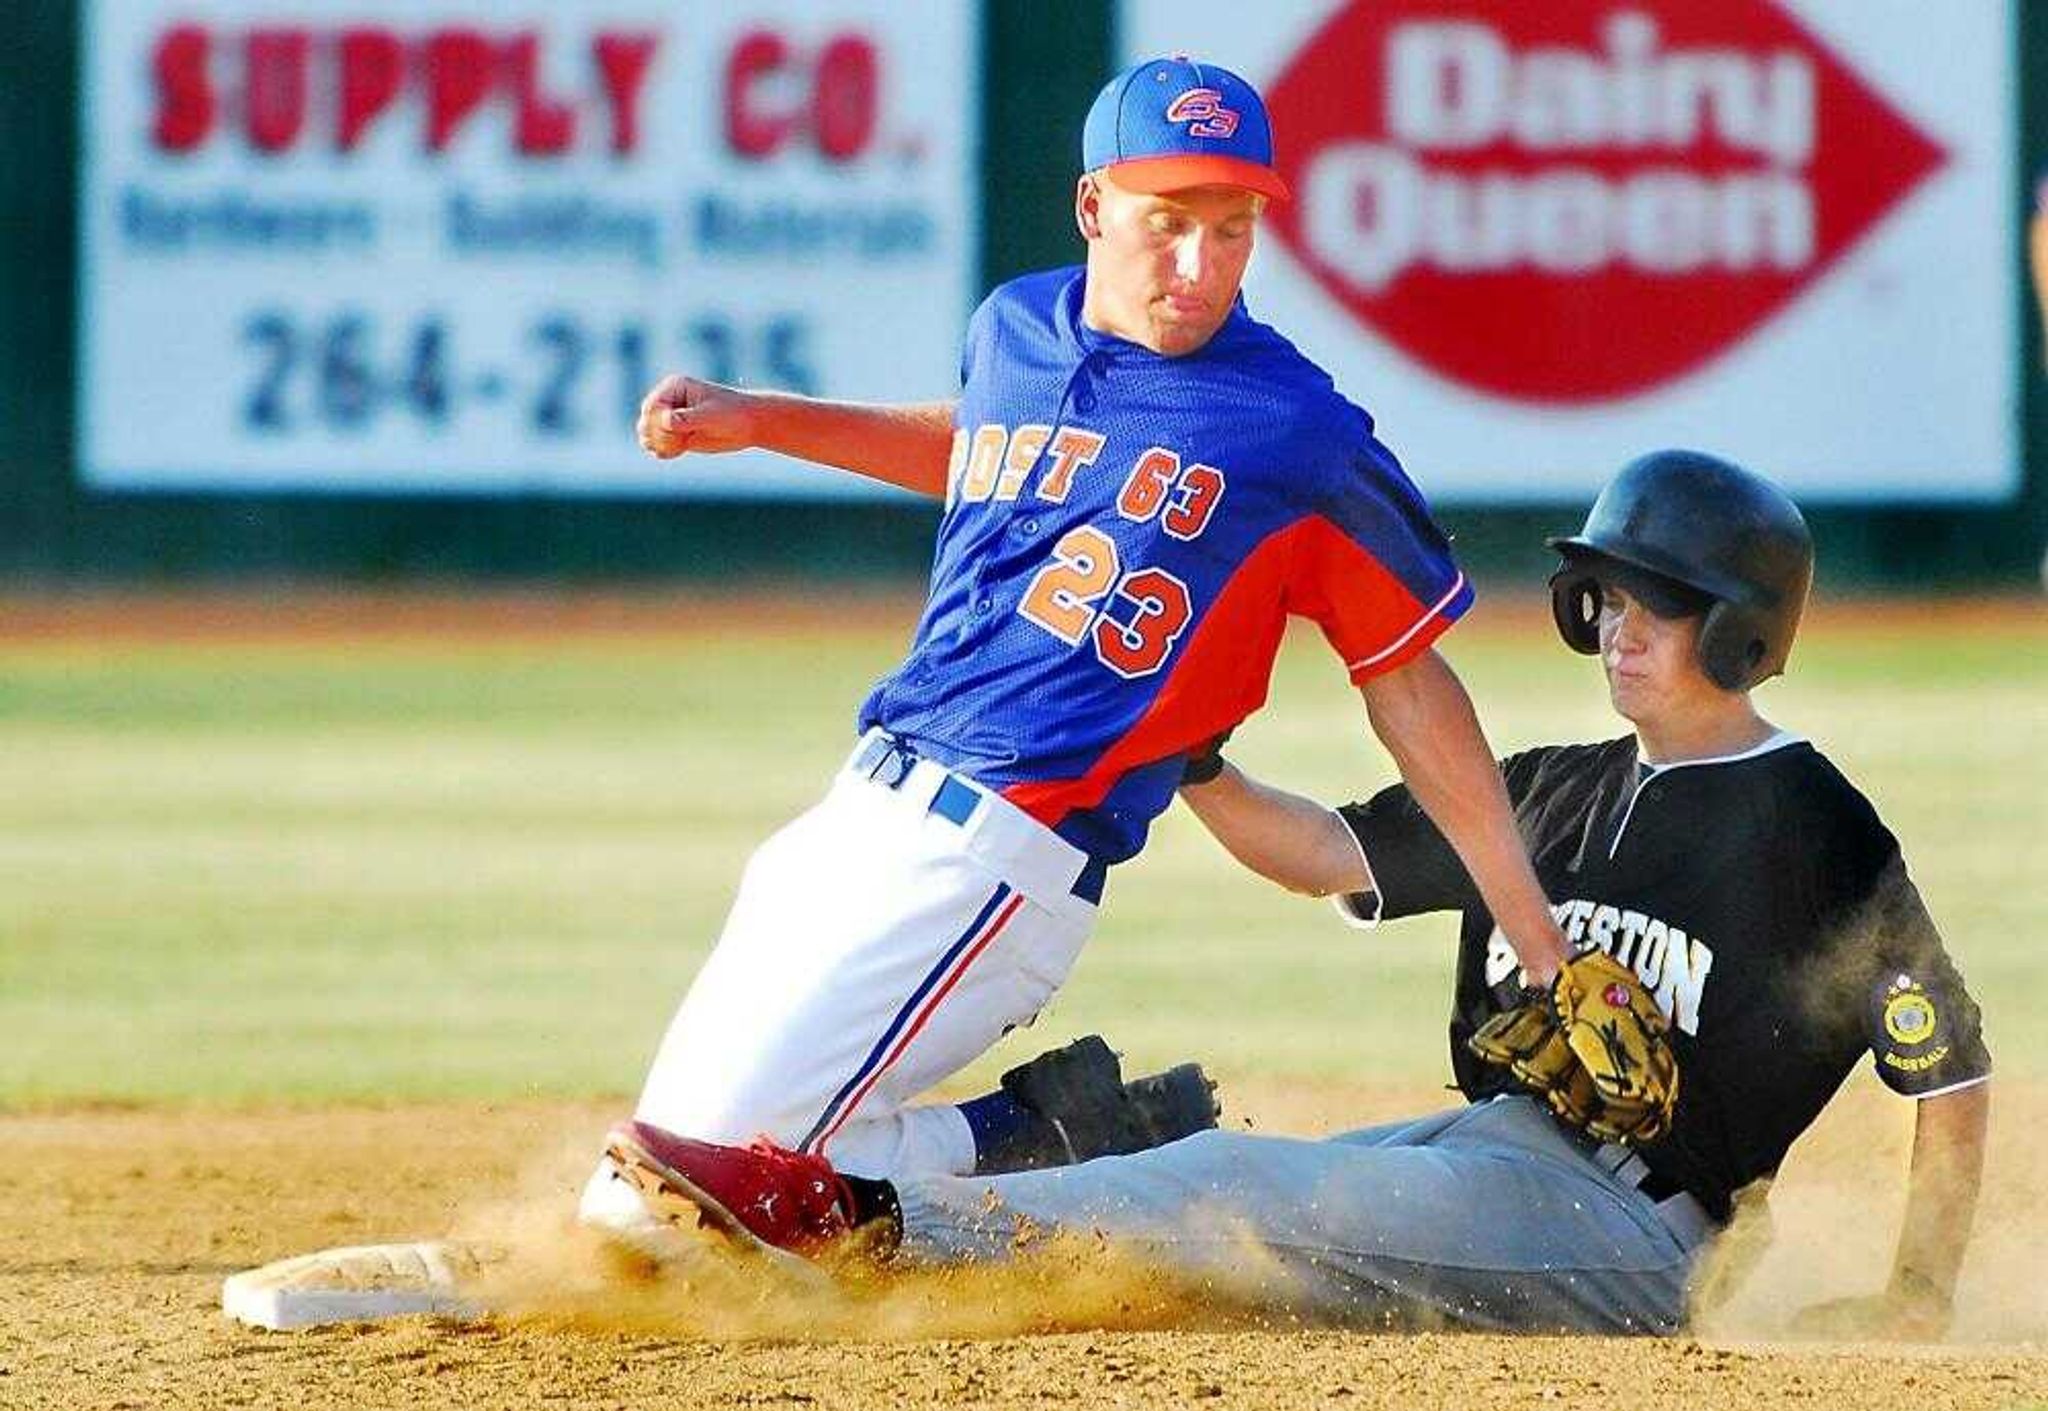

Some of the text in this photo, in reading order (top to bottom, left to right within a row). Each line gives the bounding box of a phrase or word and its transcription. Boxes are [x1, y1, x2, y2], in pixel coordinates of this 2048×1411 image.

[150, 22, 658, 158] SUPPLY
[1384, 12, 1820, 168] Dairy
[1303, 138, 1820, 296] Queen
[1116, 447, 1226, 541] 63
[1016, 524, 1192, 679] 23
